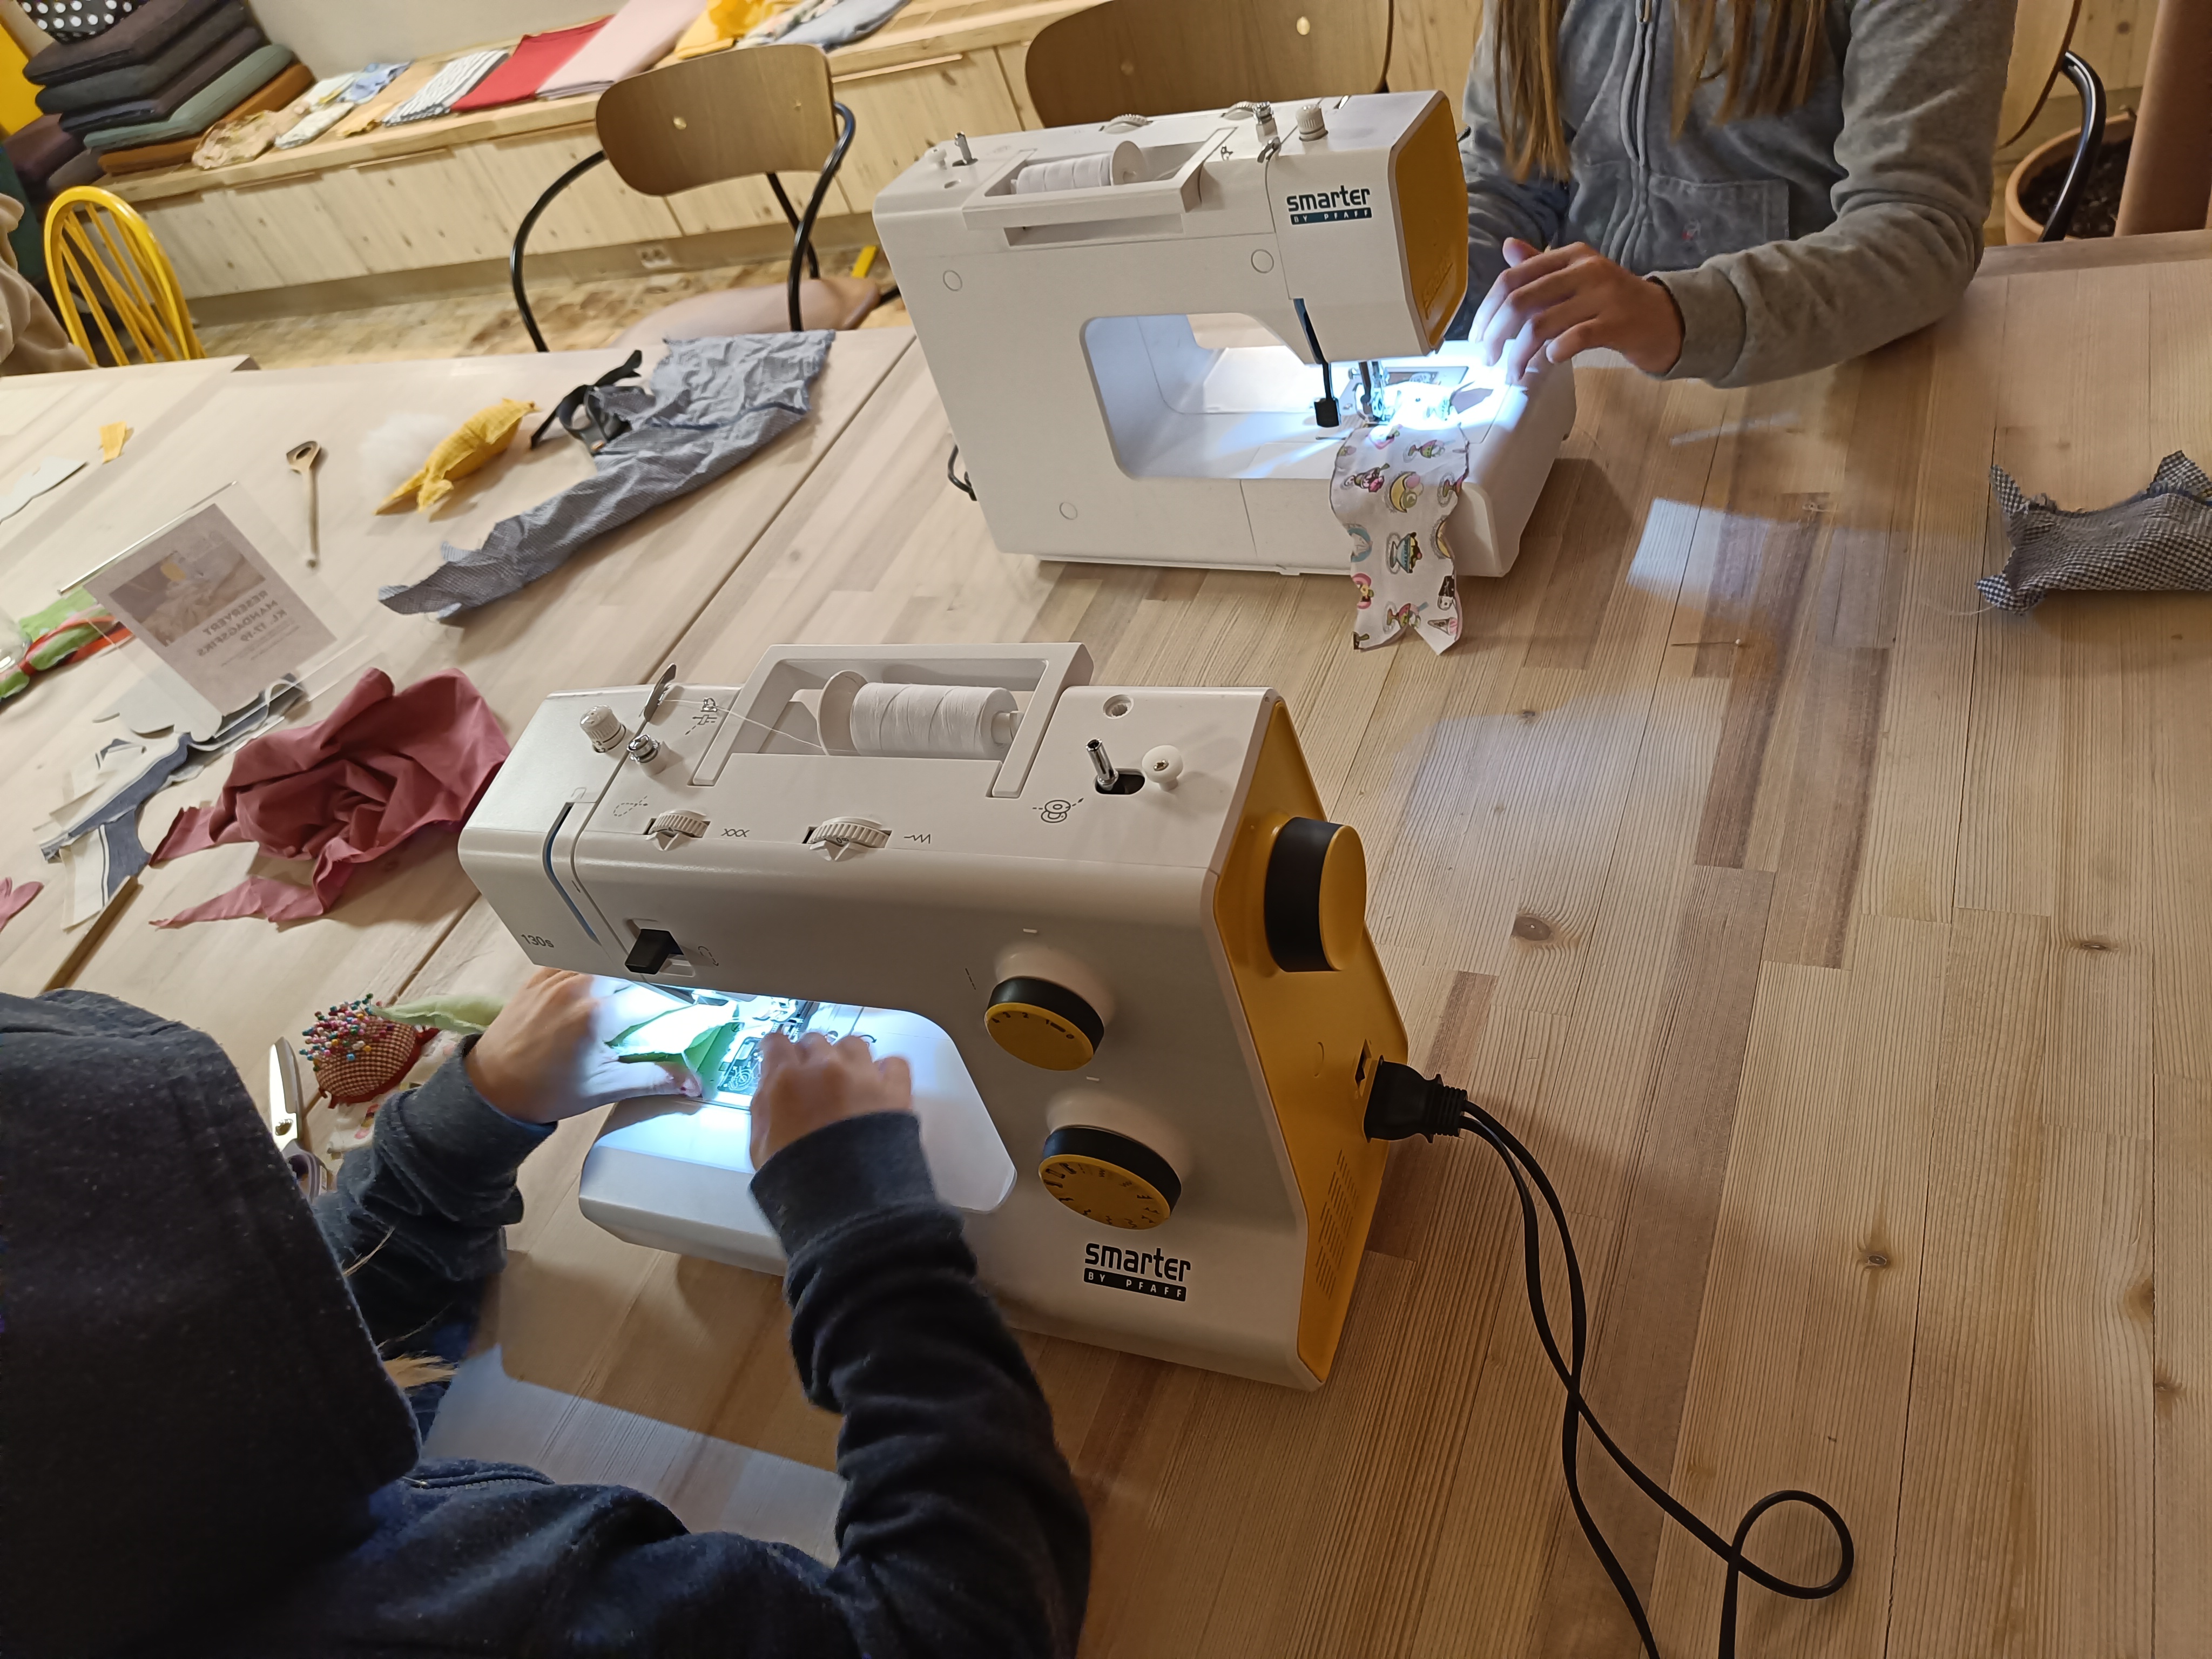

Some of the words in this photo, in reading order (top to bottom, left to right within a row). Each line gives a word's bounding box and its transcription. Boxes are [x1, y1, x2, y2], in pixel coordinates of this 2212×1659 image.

[1286, 185, 1371, 212] smarter
[521, 934, 554, 948] 130s
[1085, 1243, 1191, 1282] smarter
[1088, 1271, 1105, 1283] BY
[1126, 1279, 1182, 1297] PFAFF
